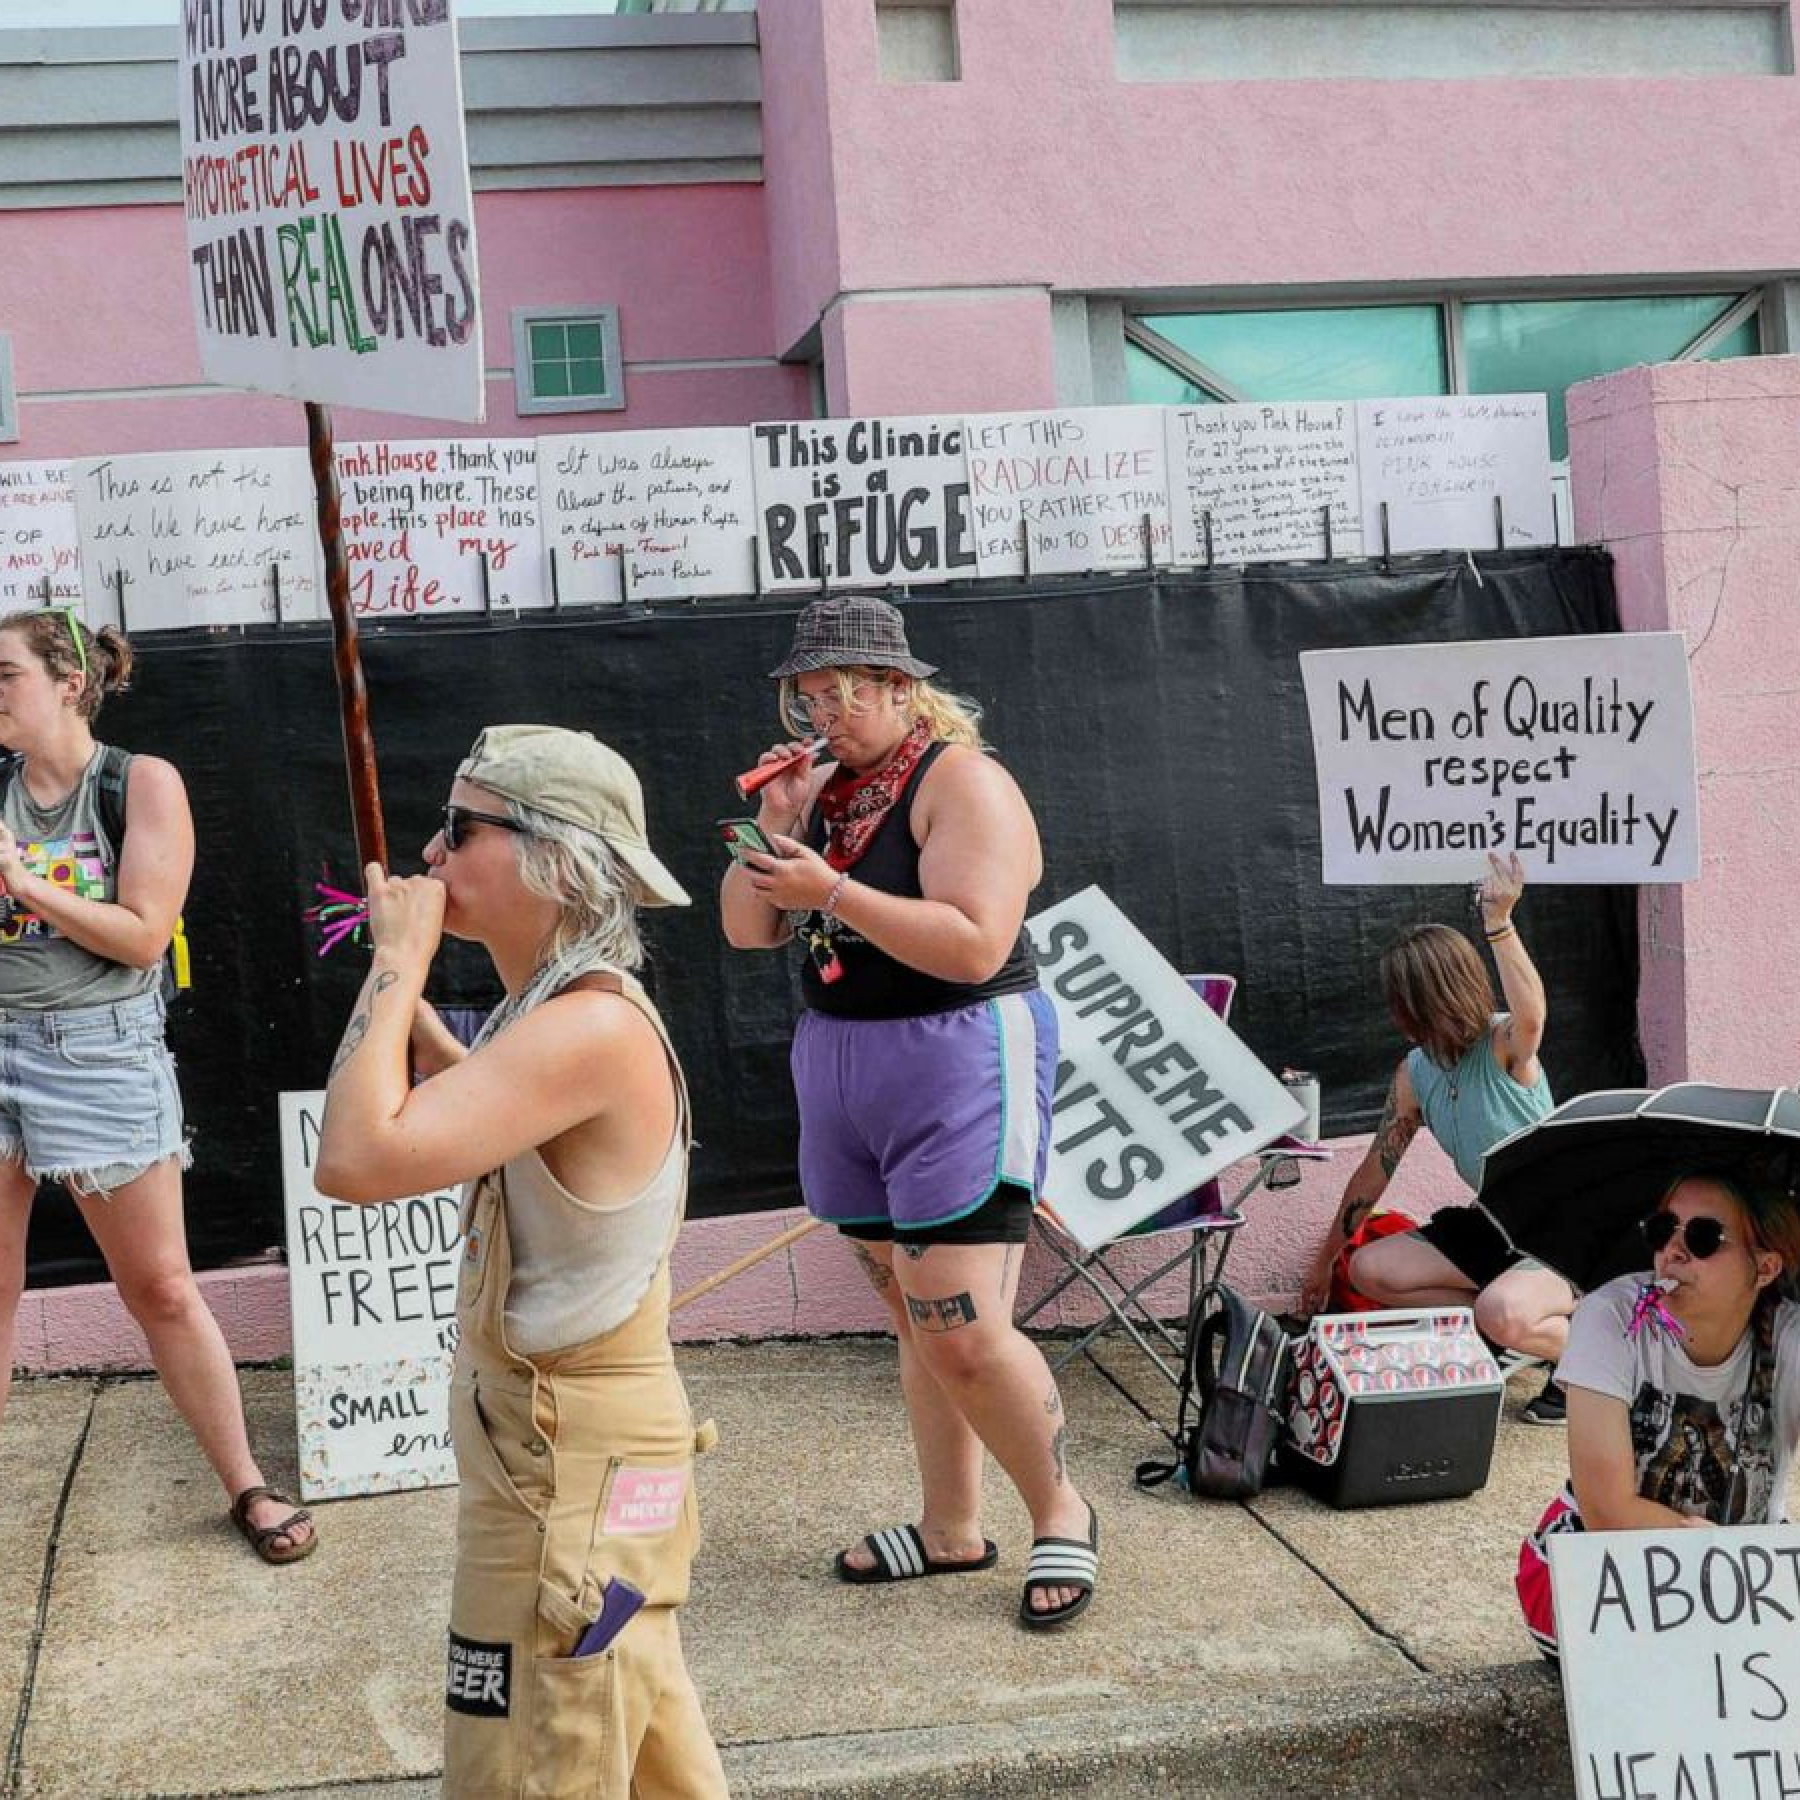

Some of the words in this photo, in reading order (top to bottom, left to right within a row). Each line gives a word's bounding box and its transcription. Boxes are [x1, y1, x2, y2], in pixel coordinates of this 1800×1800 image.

[192, 54, 263, 143] MORE
[269, 33, 406, 134] ABOUT
[332, 125, 432, 208] LIVES
[192, 225, 277, 339] THAN
[276, 212, 379, 355] REAL
[360, 213, 475, 347] ONES
[754, 423, 840, 469] This
[846, 420, 962, 465] Clinic
[968, 422, 1013, 451] LET
[1021, 418, 1085, 449] THIS
[1177, 410, 1229, 435] Thank
[338, 444, 375, 478] ink
[446, 441, 499, 472] thank
[502, 448, 537, 475] you
[811, 471, 842, 499] is
[865, 468, 889, 493] a
[971, 449, 1157, 497] RADICALIZE
[352, 478, 415, 513] being
[418, 475, 471, 503] here.
[473, 475, 538, 506] These
[976, 503, 1013, 529] YOU
[1019, 493, 1116, 525] RATHER
[1117, 490, 1167, 513] THAN
[14, 528, 43, 545] OF
[194, 501, 247, 539] have
[386, 506, 429, 532] this
[434, 503, 487, 539] place
[497, 506, 537, 530] has
[764, 481, 977, 580] REFUGE
[1031, 532, 1060, 556] YOU
[1062, 530, 1091, 549] TO
[346, 528, 412, 563] aved
[456, 537, 517, 571] my
[1337, 677, 1435, 742] Men
[1451, 679, 1491, 739] of
[1504, 674, 1656, 744] Quality
[1424, 745, 1578, 797] respect
[1344, 783, 1506, 855] Women's
[1515, 791, 1679, 867] Equality
[1034, 920, 1255, 1157] SUPREME
[1051, 1059, 1166, 1201] NTS
[299, 1197, 461, 1265] REPROD
[320, 1259, 457, 1327] FREE
[327, 1388, 429, 1431] SMALL
[1714, 1651, 1788, 1721] IS
